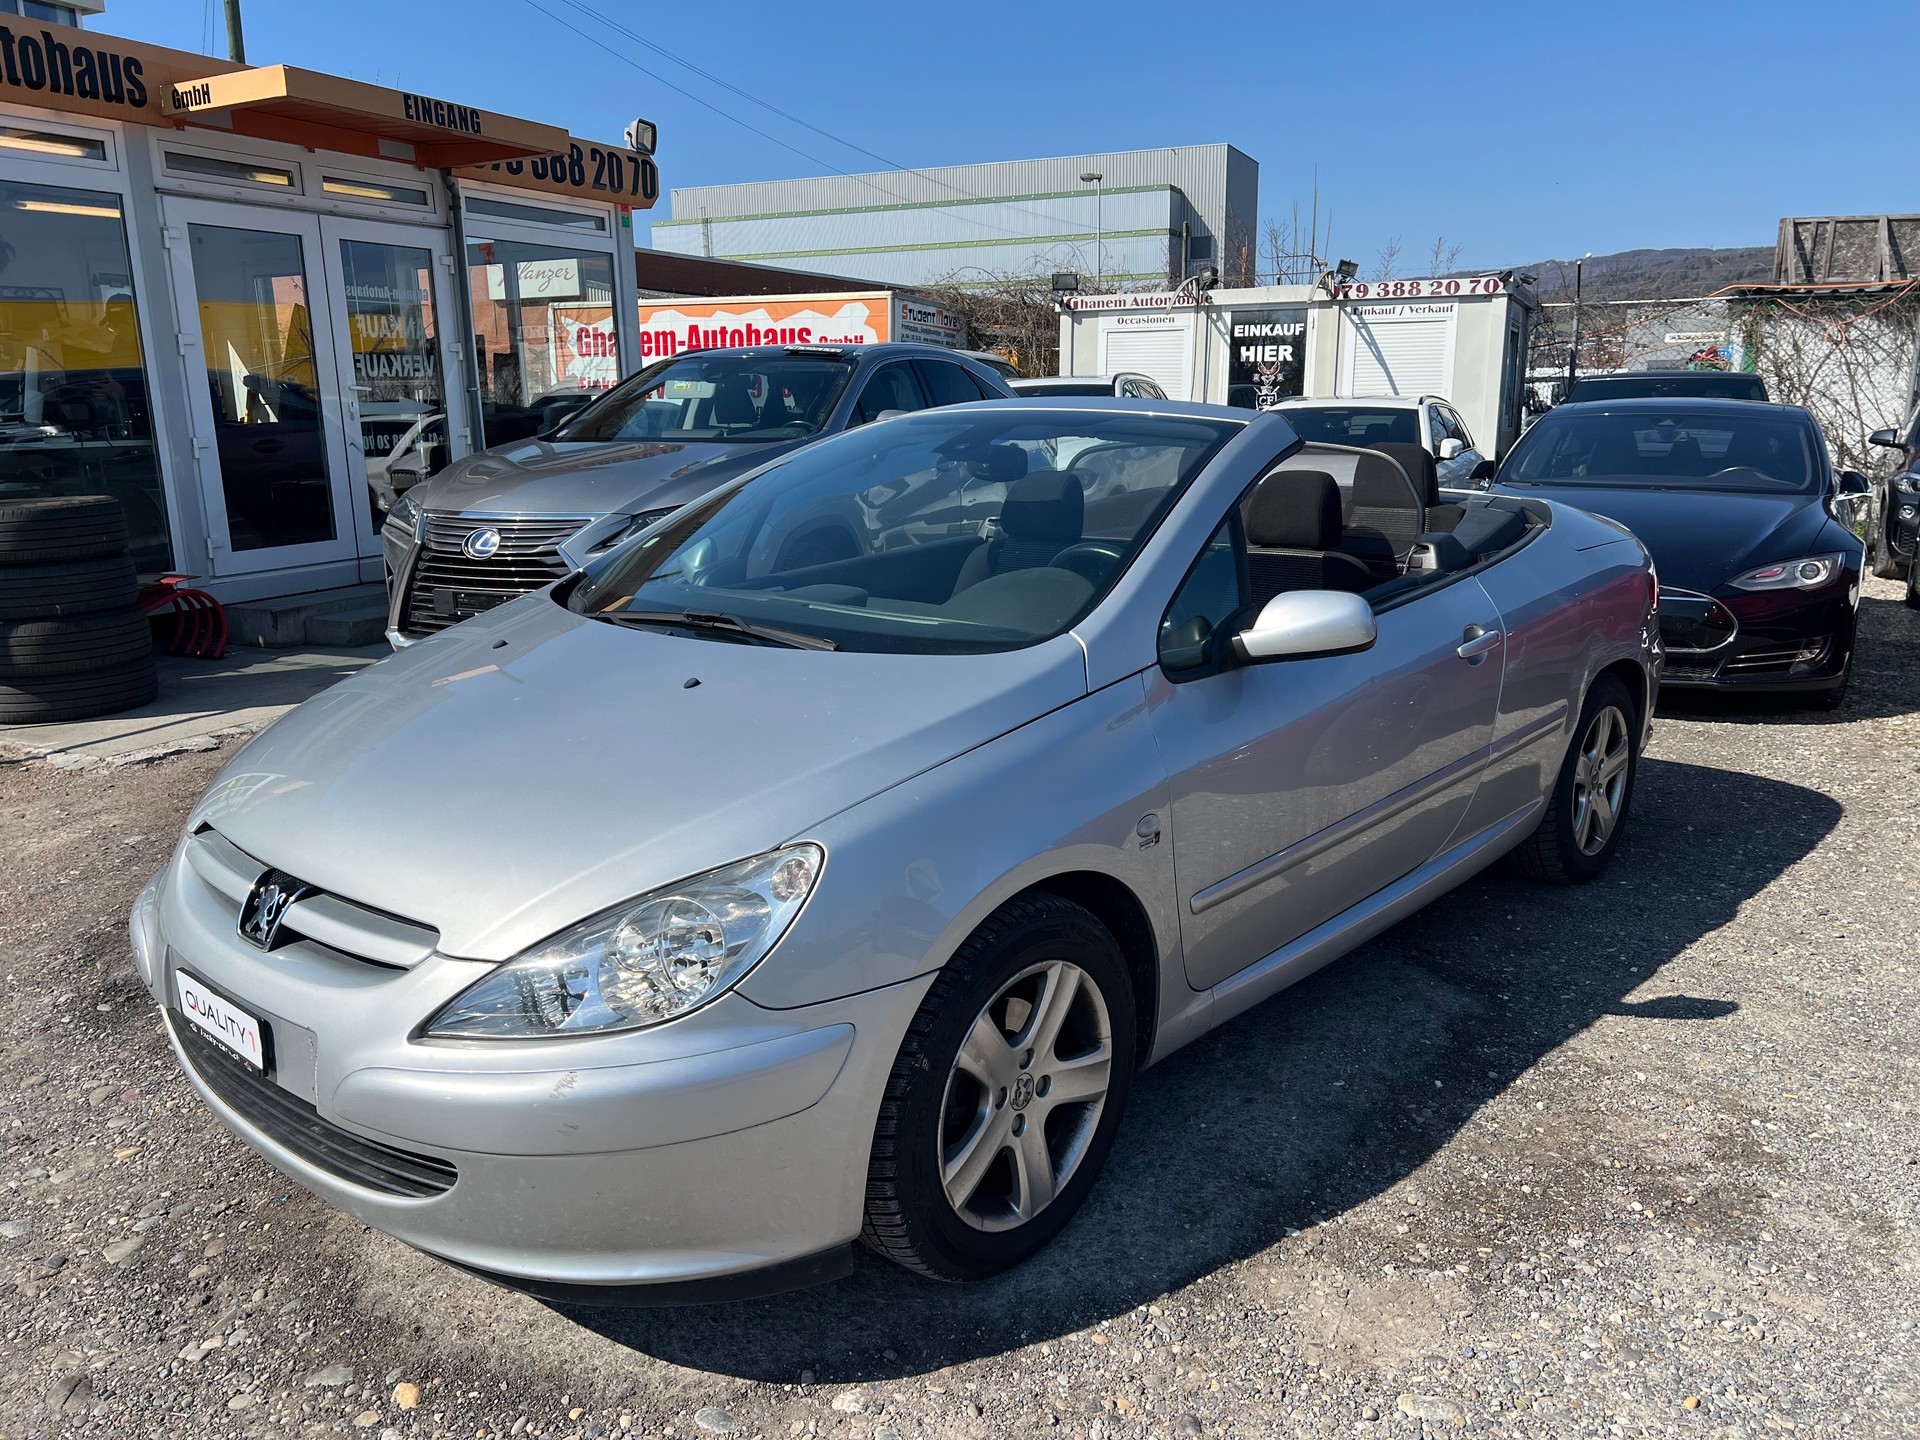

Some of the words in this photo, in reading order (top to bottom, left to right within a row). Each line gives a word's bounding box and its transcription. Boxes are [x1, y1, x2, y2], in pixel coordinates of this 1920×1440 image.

[0, 26, 148, 108] tohaus
[171, 83, 212, 110] GmbH
[402, 93, 482, 135] EINGANG
[590, 147, 624, 194] 20
[626, 154, 656, 200] 70
[497, 261, 576, 293] lanzer
[1377, 281, 1422, 298] 388
[1430, 280, 1461, 296] 20
[1469, 278, 1501, 294] 70
[1066, 296, 1123, 311] Ghanem
[1130, 292, 1214, 308] Automoble
[1353, 305, 1398, 317] Einkauf
[1408, 304, 1456, 315] Verkauf
[1117, 315, 1176, 326] Occasionen
[1233, 322, 1305, 338] EINKAUF
[576, 322, 813, 358] Ghaem-Autohaus
[1240, 345, 1294, 362] HIER
